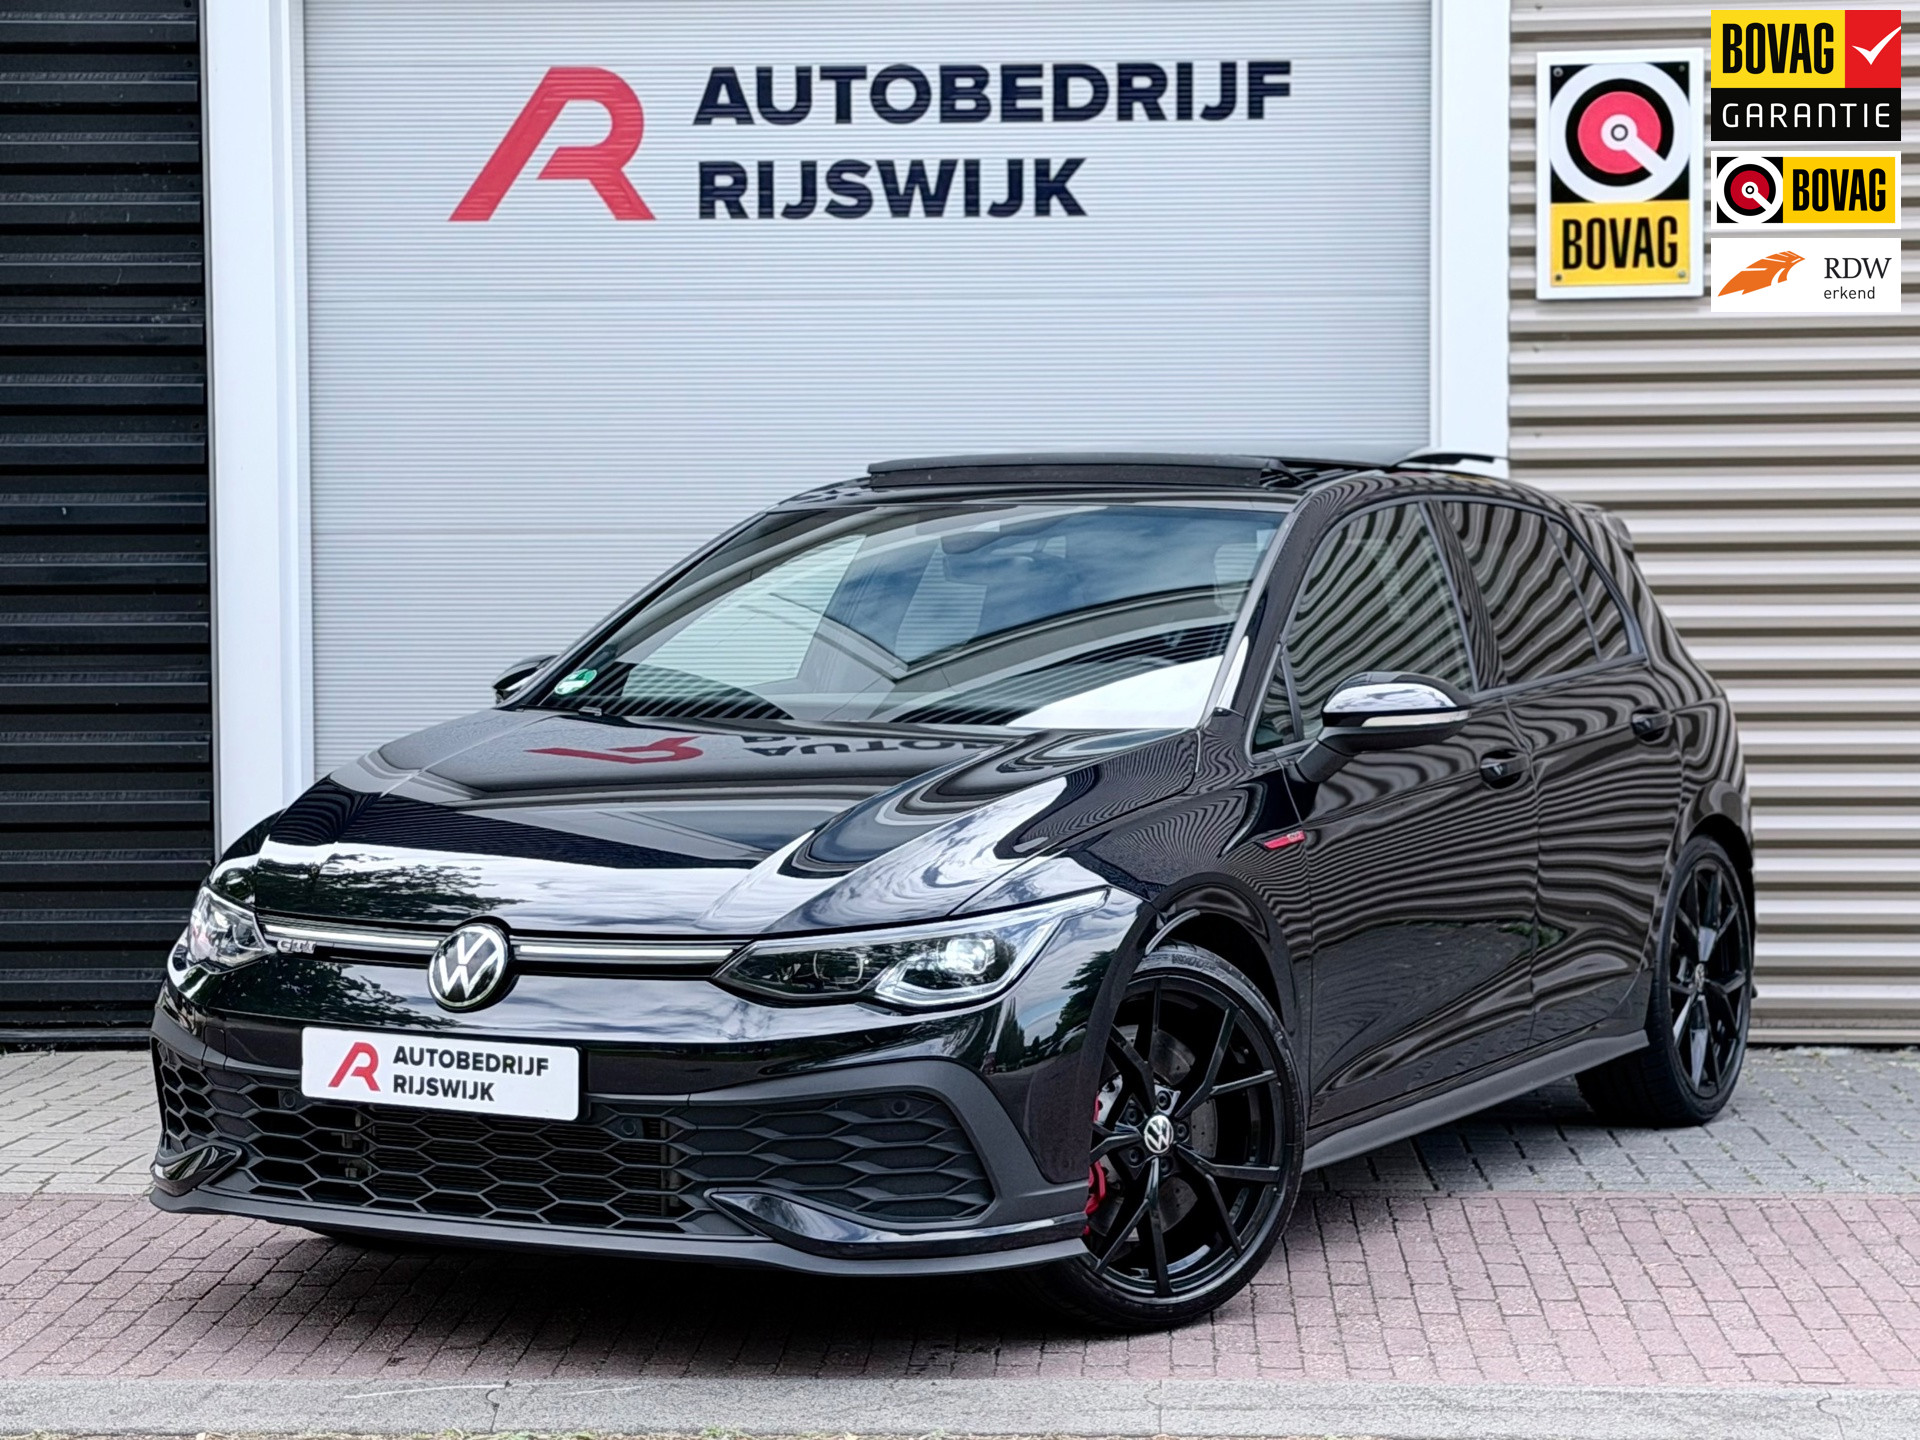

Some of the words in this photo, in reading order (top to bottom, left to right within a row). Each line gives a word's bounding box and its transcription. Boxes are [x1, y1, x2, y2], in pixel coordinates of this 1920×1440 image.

[693, 60, 1292, 126] AUTOBEDRIJF
[698, 158, 1086, 220] RIJSWIJK
[1562, 215, 1678, 270] BOVAG
[393, 1045, 549, 1077] AUTOBEDRIJF
[393, 1075, 495, 1102] RIJSWIJK
